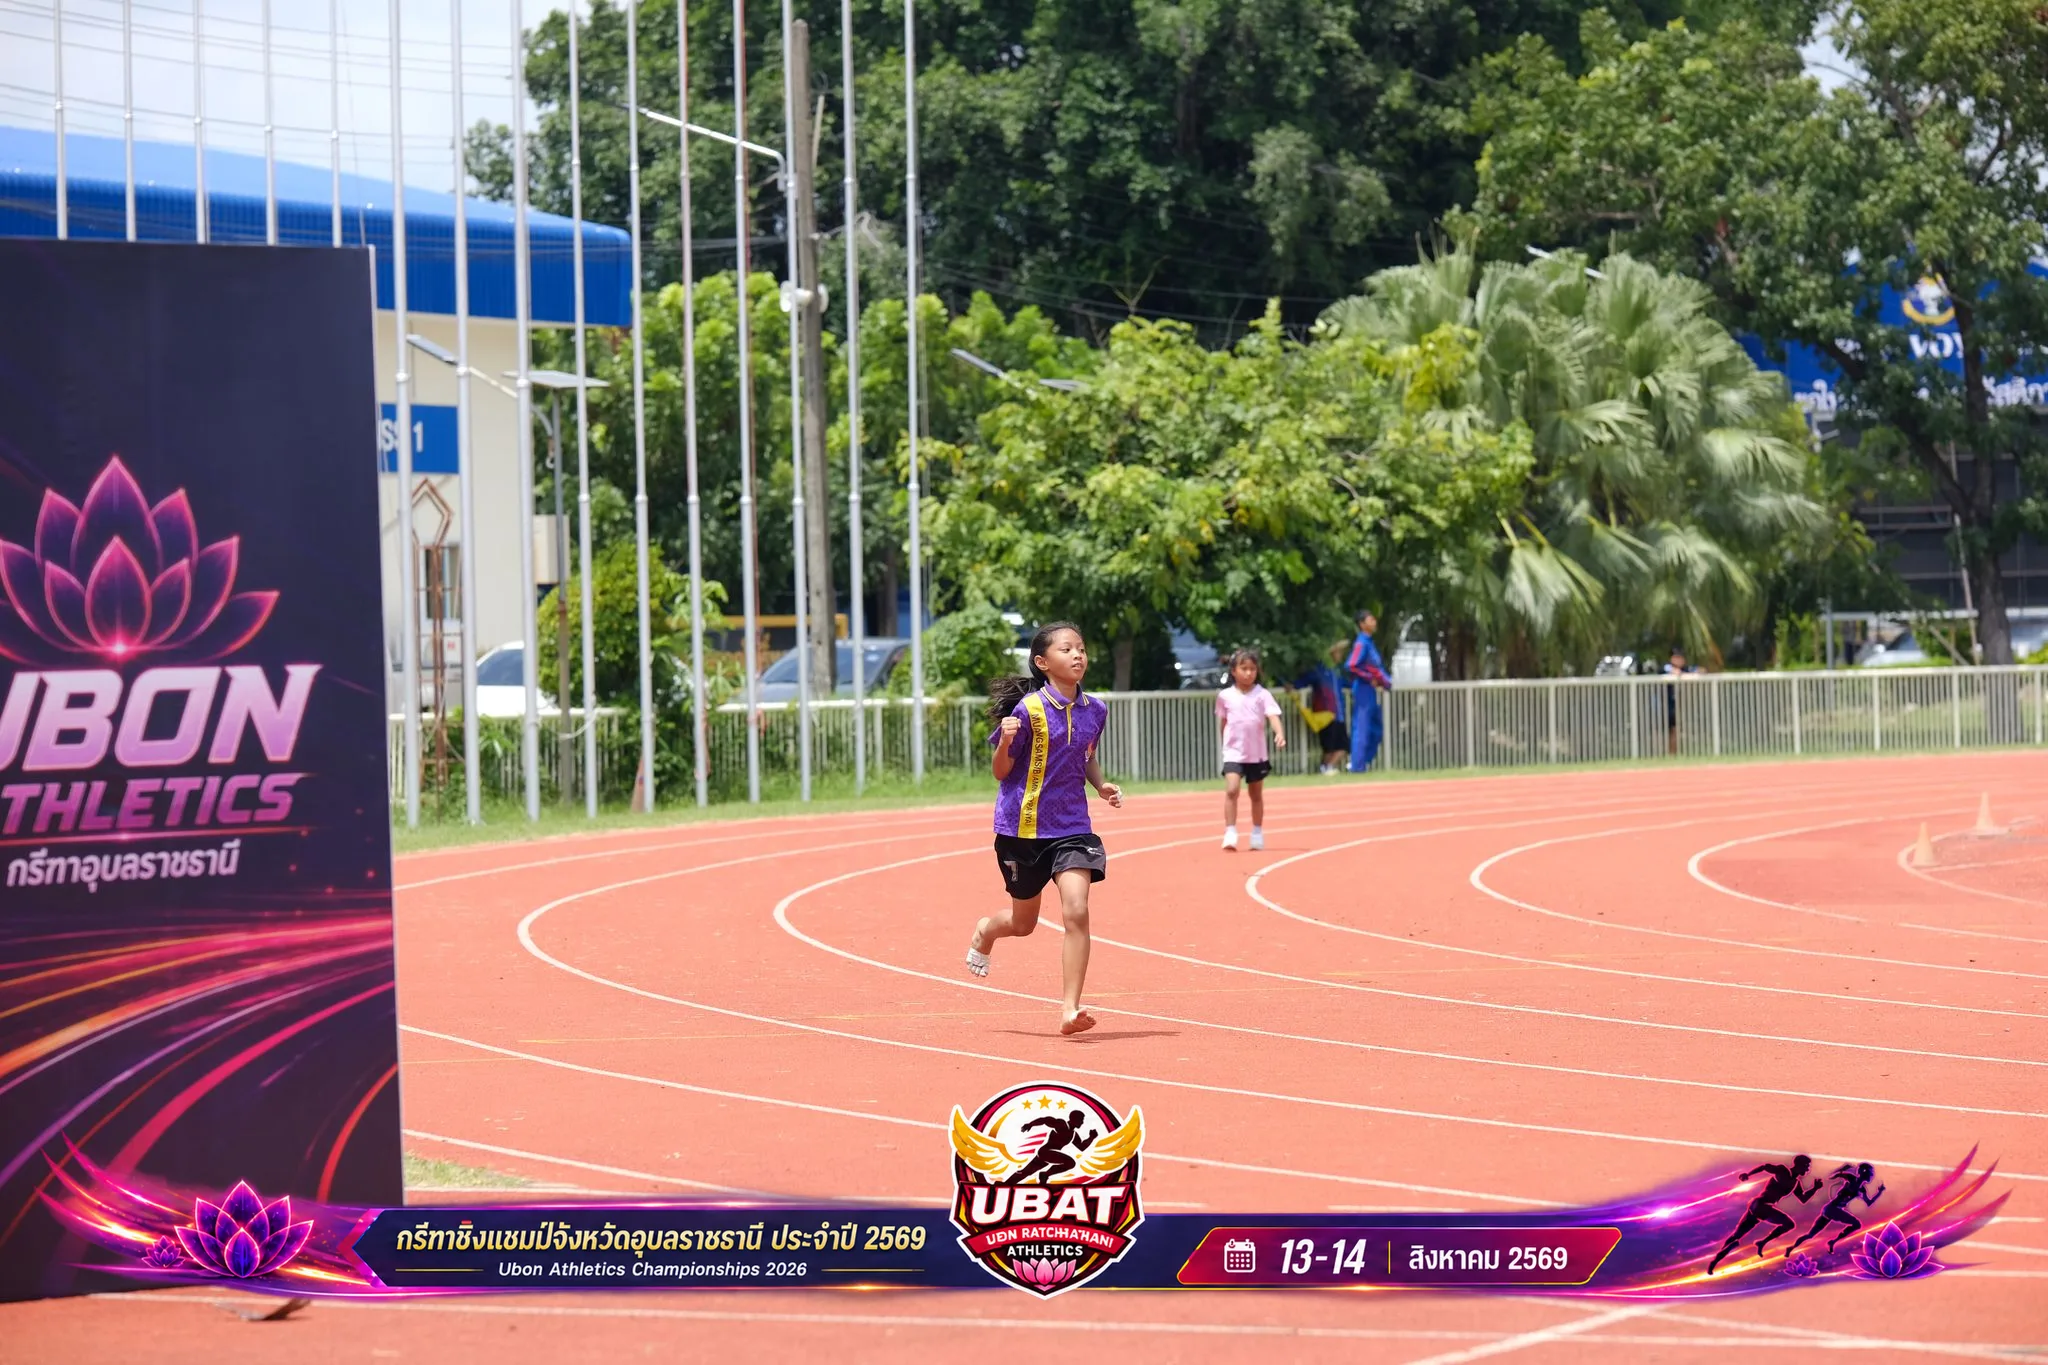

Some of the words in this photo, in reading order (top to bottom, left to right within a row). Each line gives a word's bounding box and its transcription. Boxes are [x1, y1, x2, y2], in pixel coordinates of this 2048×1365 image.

[6, 838, 241, 893] กรีฑาอุบลราชธานี
